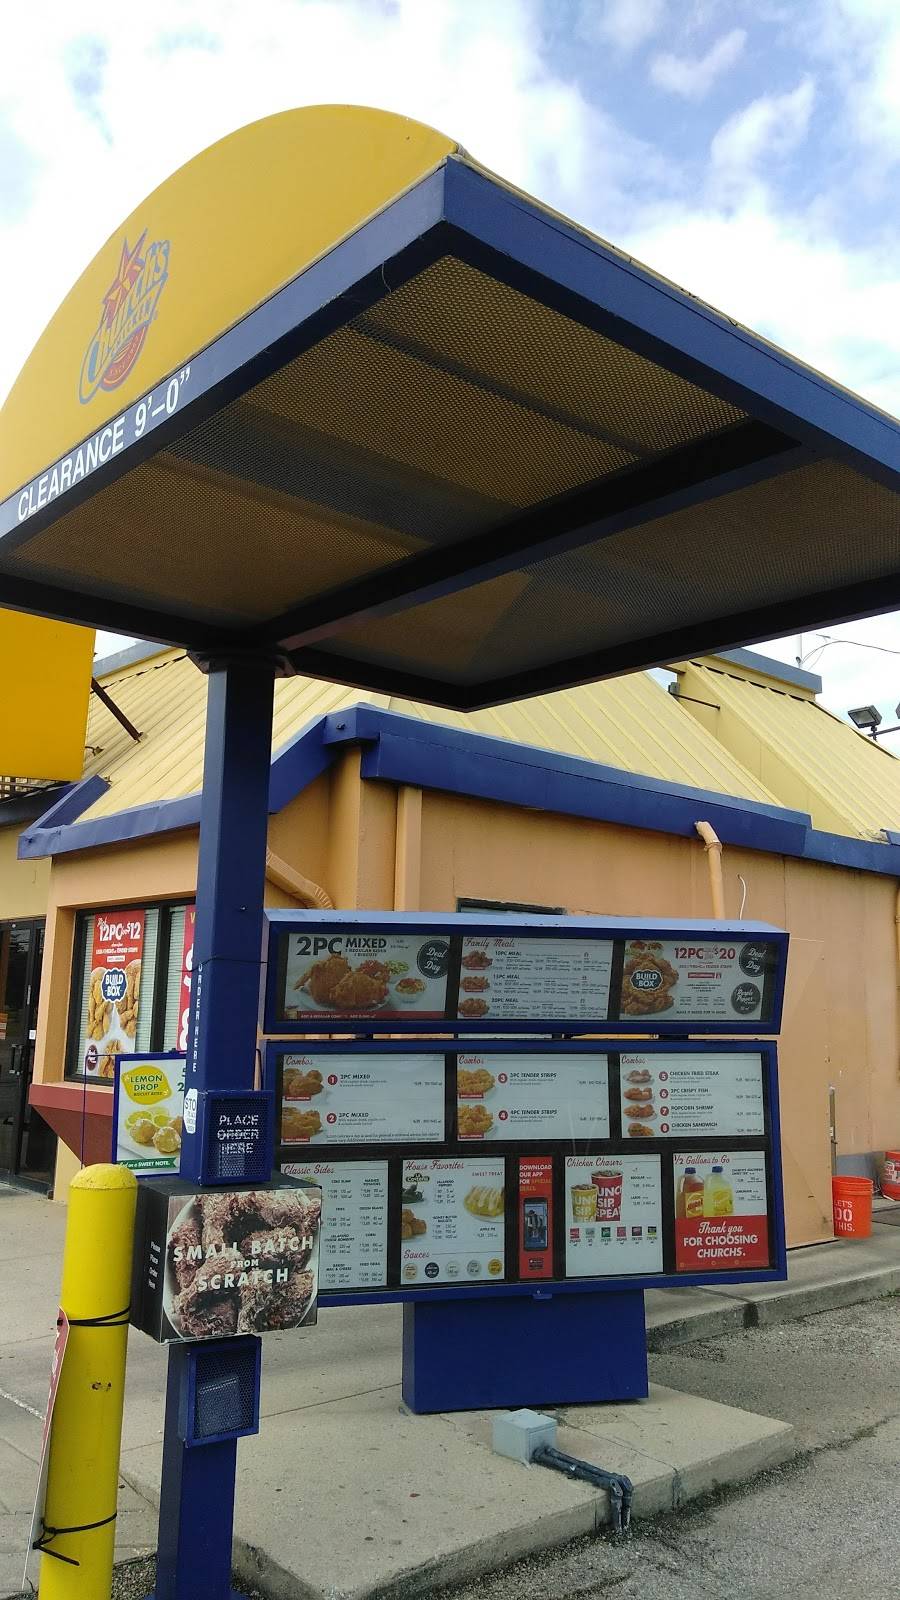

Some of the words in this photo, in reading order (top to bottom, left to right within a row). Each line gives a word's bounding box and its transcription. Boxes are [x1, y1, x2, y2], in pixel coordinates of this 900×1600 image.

[18, 418, 125, 521] CLEARANCE
[296, 936, 343, 956] 2PC
[345, 937, 387, 949] MIXED
[464, 937, 490, 950] Family
[494, 938, 515, 948] Meals
[427, 947, 448, 959] Deal
[675, 947, 704, 960] 12PC
[425, 961, 441, 974] Day
[746, 960, 761, 973] Day
[105, 974, 123, 985] BUILD
[635, 973, 658, 981] BUILD
[107, 986, 121, 996] BOX
[192, 1025, 200, 1073] HERE
[286, 1056, 313, 1065] Combos
[458, 1055, 484, 1064] Combos
[131, 1075, 162, 1083] LEMON
[134, 1083, 159, 1091] DROP
[185, 1098, 197, 1111] STO
[219, 1114, 259, 1126] PLACE
[217, 1129, 260, 1140] ORDER
[221, 1142, 254, 1154] HERE
[405, 1160, 428, 1170] House
[430, 1160, 464, 1170] Favorites
[566, 1157, 594, 1167] Chicken
[595, 1157, 624, 1167] Chasers
[685, 1155, 711, 1165] Gallons
[711, 1156, 719, 1164] to
[720, 1155, 730, 1164] Go
[284, 1165, 311, 1175] Classic
[314, 1164, 335, 1174] Sides
[698, 1221, 726, 1234] Thank
[728, 1225, 744, 1236] you
[683, 1237, 703, 1247] FOR
[705, 1235, 759, 1246] CHOOSING
[173, 1242, 240, 1262] SMALL
[251, 1236, 314, 1255] BATCH
[404, 1249, 430, 1259] Sauces
[697, 1247, 746, 1258] CHURCHS.
[232, 1259, 259, 1269] FROM
[198, 1268, 288, 1291] SCRATCH
